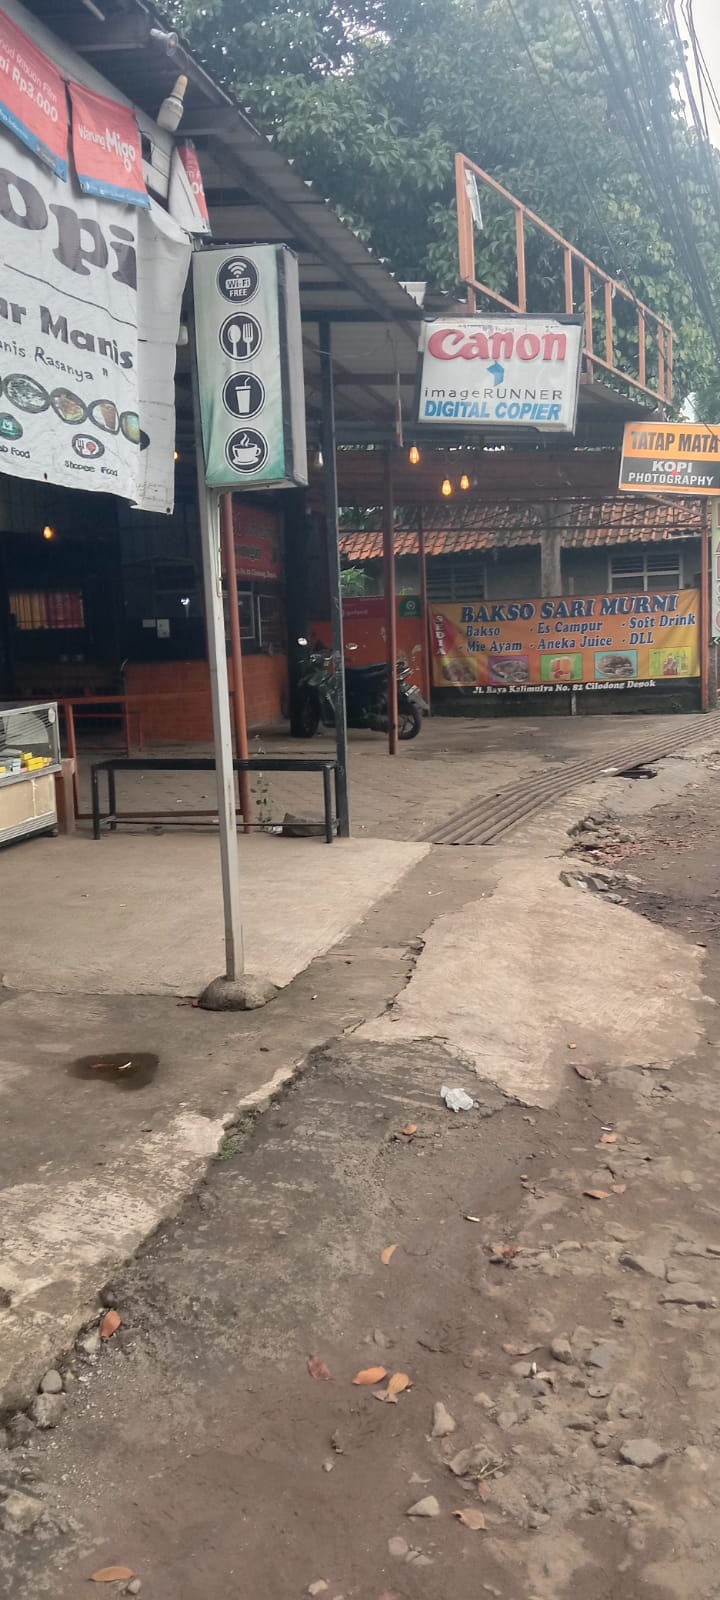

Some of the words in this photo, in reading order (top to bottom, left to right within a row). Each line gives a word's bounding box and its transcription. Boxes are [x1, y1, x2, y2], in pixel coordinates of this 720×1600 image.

[12, 67, 58, 122] Rp3.000
[79, 124, 106, 150] Warung
[105, 127, 136, 173] Migo
[230, 289, 248, 297] FREE
[40, 305, 133, 369] Manis
[428, 328, 567, 361] Canon
[35, 346, 94, 383] Rasanya
[424, 387, 563, 400] imageRUNNER
[424, 400, 490, 418] DIGITAL
[495, 402, 562, 421] COPIER
[11, 446, 30, 459] Food
[631, 431, 675, 452] TATAP
[677, 433, 719, 453] MATA
[652, 460, 693, 473] KOPI
[628, 472, 714, 486] PHOTOGRAPHY
[461, 602, 536, 623] BAKSO
[541, 598, 596, 619] SARI
[600, 593, 680, 616] MURNI
[435, 615, 446, 655] SEDIA
[466, 625, 500, 637] Bakso
[537, 622, 550, 634] Es
[554, 621, 603, 635] Campur
[629, 617, 655, 629] Soft
[659, 613, 696, 627] Drink
[467, 640, 486, 652] Mie
[489, 640, 522, 653] Ayam
[537, 638, 576, 650] Aneka
[580, 635, 613, 648] Juice
[629, 632, 654, 645] DLL
[486, 685, 506, 695] Raya
[585, 681, 625, 691] Cilodong
[627, 679, 656, 690] Depok
